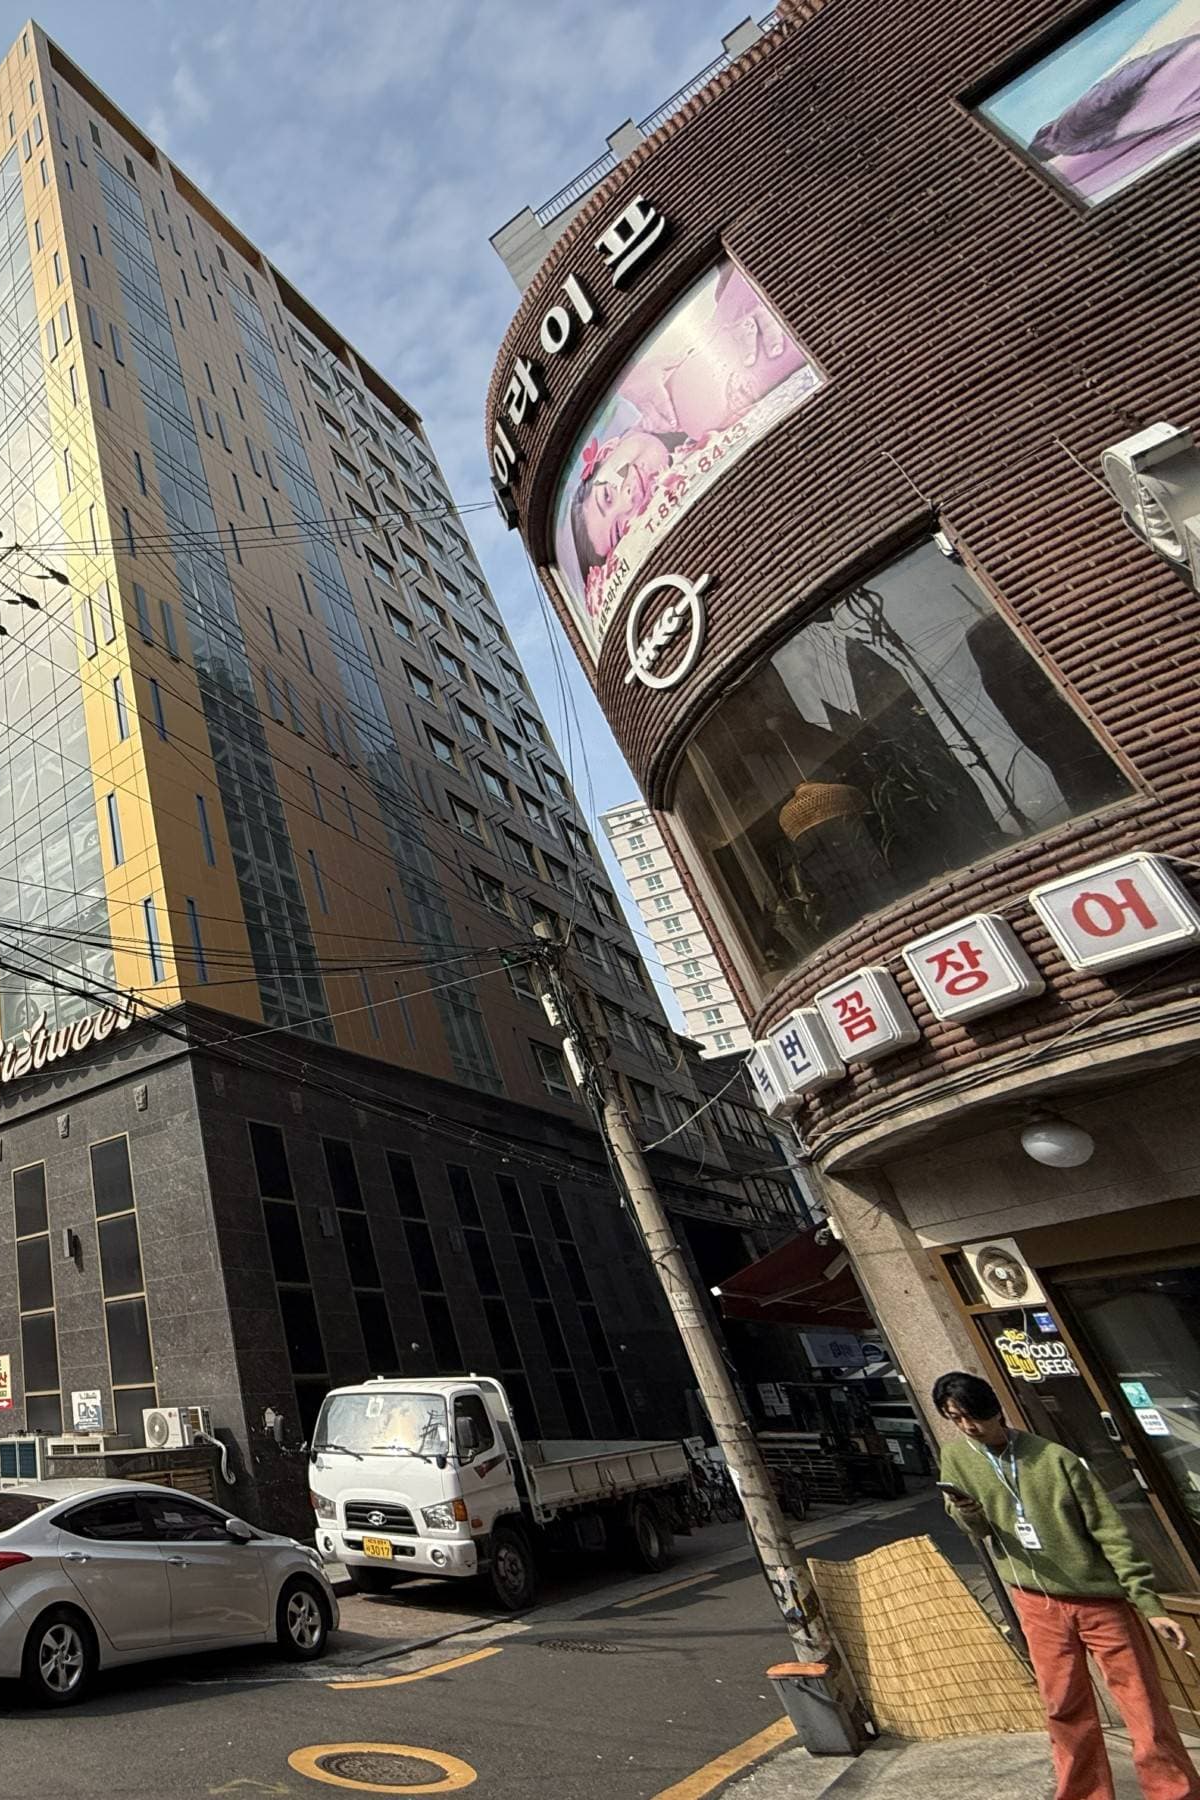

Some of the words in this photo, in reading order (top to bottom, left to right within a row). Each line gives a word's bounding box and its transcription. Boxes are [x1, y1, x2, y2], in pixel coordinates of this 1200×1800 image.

[490, 194, 665, 530] 이라이프
[1029, 1341, 1067, 1358] COLD
[1035, 1359, 1075, 1376] BEER
